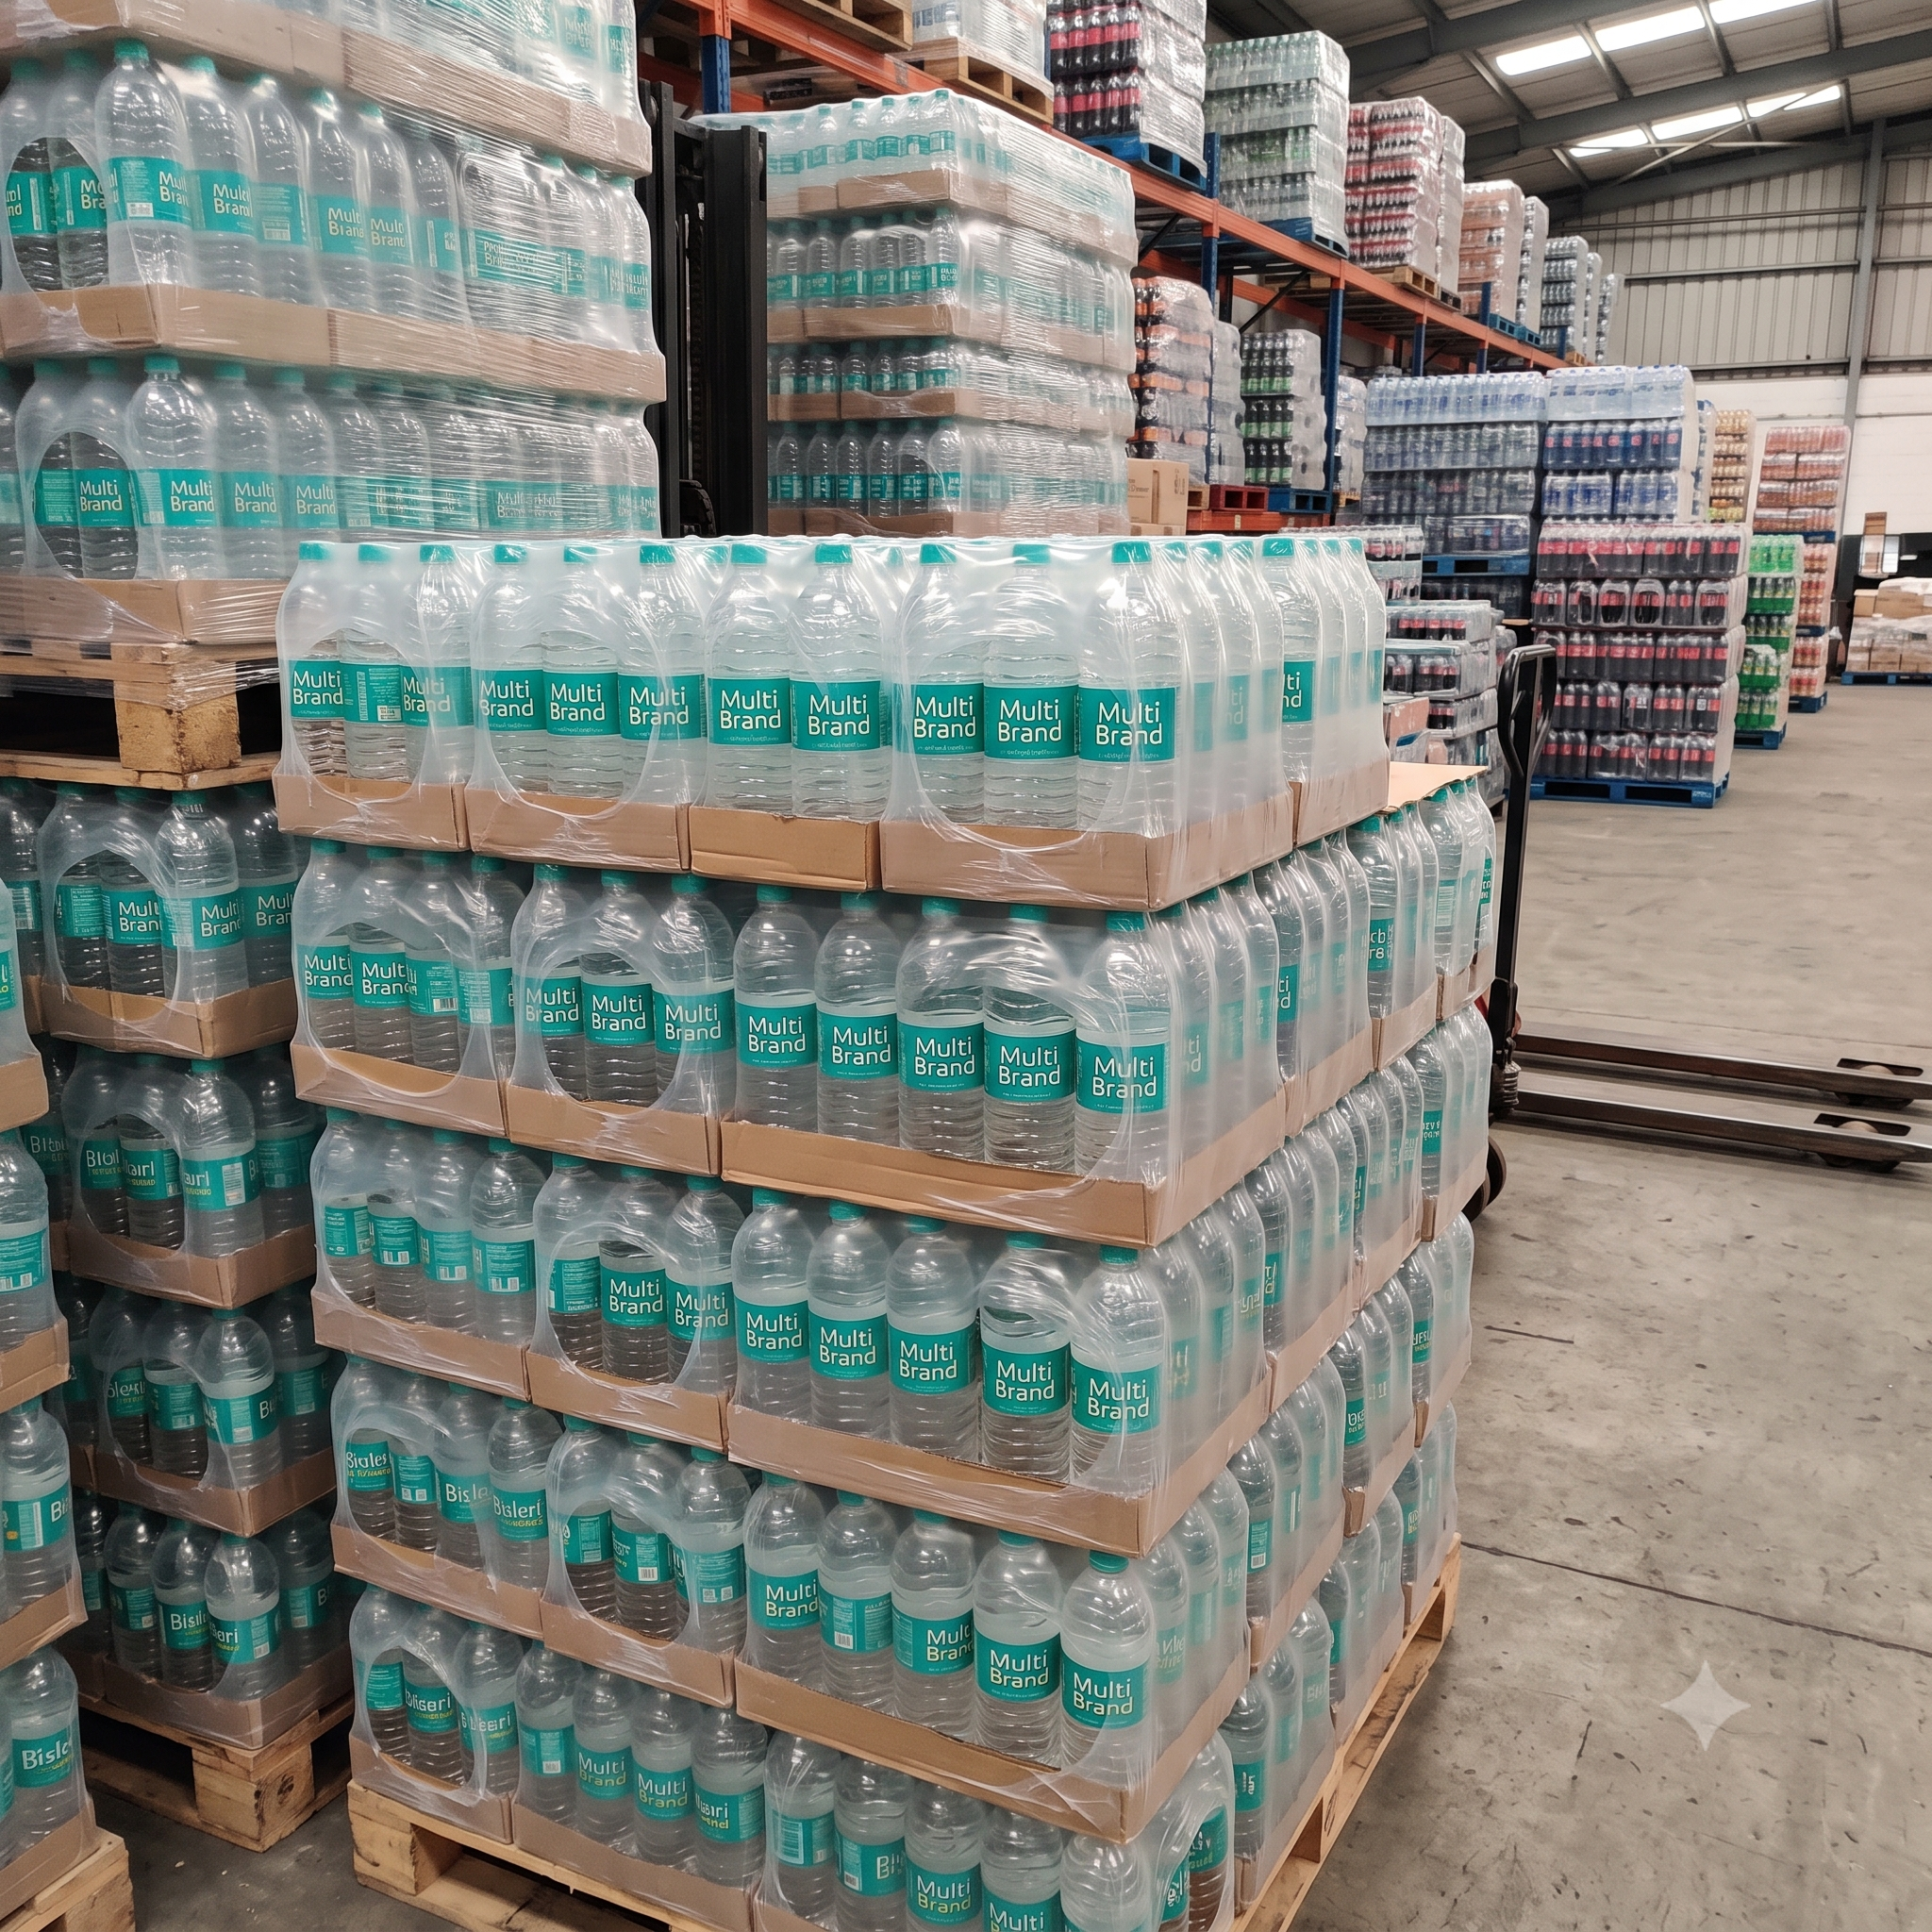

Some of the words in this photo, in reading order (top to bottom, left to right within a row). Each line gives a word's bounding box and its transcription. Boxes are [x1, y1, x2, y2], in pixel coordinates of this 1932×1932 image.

[80, 480, 118, 496] Multi
[171, 480, 212, 497] Multi
[80, 496, 123, 512] Brand
[171, 497, 215, 512] Brand
[293, 671, 341, 689] Multi
[404, 676, 445, 694] Multi
[481, 680, 530, 700] Multi
[292, 688, 343, 706] Brand
[404, 694, 451, 712] Brand
[550, 683, 602, 703] Multi
[630, 687, 686, 708] Multi
[721, 690, 777, 710] Multi
[480, 698, 534, 718] Brand
[550, 702, 606, 722] Brand
[809, 694, 867, 716] Multi
[915, 696, 974, 718] Multi
[1000, 699, 1059, 722] Multi
[1098, 702, 1160, 724] Multi
[629, 706, 689, 726] Brand
[720, 709, 781, 730] Brand
[808, 714, 870, 737] Brand
[913, 716, 976, 739] Brand
[998, 720, 1062, 742] Brand
[1096, 723, 1162, 746] Brand
[526, 988, 575, 1006] Multi
[591, 994, 642, 1012] Multi
[525, 1004, 578, 1023] Brand
[591, 1012, 646, 1030] Brand
[665, 1004, 718, 1023] Multi
[665, 1021, 722, 1041] Brand
[748, 1016, 802, 1035] Multi
[833, 1026, 888, 1046] Multi
[748, 1034, 806, 1053] Brand
[916, 1036, 972, 1058] Multi
[832, 1044, 891, 1065] Brand
[1001, 1045, 1058, 1066] Multi
[914, 1054, 975, 1077] Brand
[998, 1065, 1060, 1087] Brand
[1094, 1057, 1154, 1078] Multi
[1092, 1076, 1157, 1098] Brand
[610, 1278, 659, 1297] Multi
[609, 1295, 662, 1314] Brand
[675, 1291, 725, 1310] Multi
[675, 1308, 728, 1327] Brand
[746, 1311, 797, 1332] Multi
[746, 1329, 802, 1350] Brand
[821, 1326, 873, 1348] Multi
[820, 1344, 876, 1366] Brand
[900, 1341, 954, 1362] Multi
[899, 1359, 958, 1381] Brand
[997, 1360, 1052, 1382] Multi
[995, 1379, 1054, 1401] Brand
[1090, 1377, 1146, 1401] Multi
[1088, 1396, 1149, 1420] Brand
[991, 1649, 1047, 1672] Multi
[991, 1667, 1049, 1689] Brand
[1074, 1673, 1131, 1698] Multi
[1074, 1691, 1133, 1715] Brand
[578, 1752, 625, 1774] Multi
[579, 1770, 626, 1787] Brand
[638, 1773, 686, 1795] Multi
[639, 1790, 688, 1808] Brand
[917, 1875, 971, 1899] Multi
[918, 1892, 972, 1914] Brand
[991, 1903, 1043, 1931] Multi
